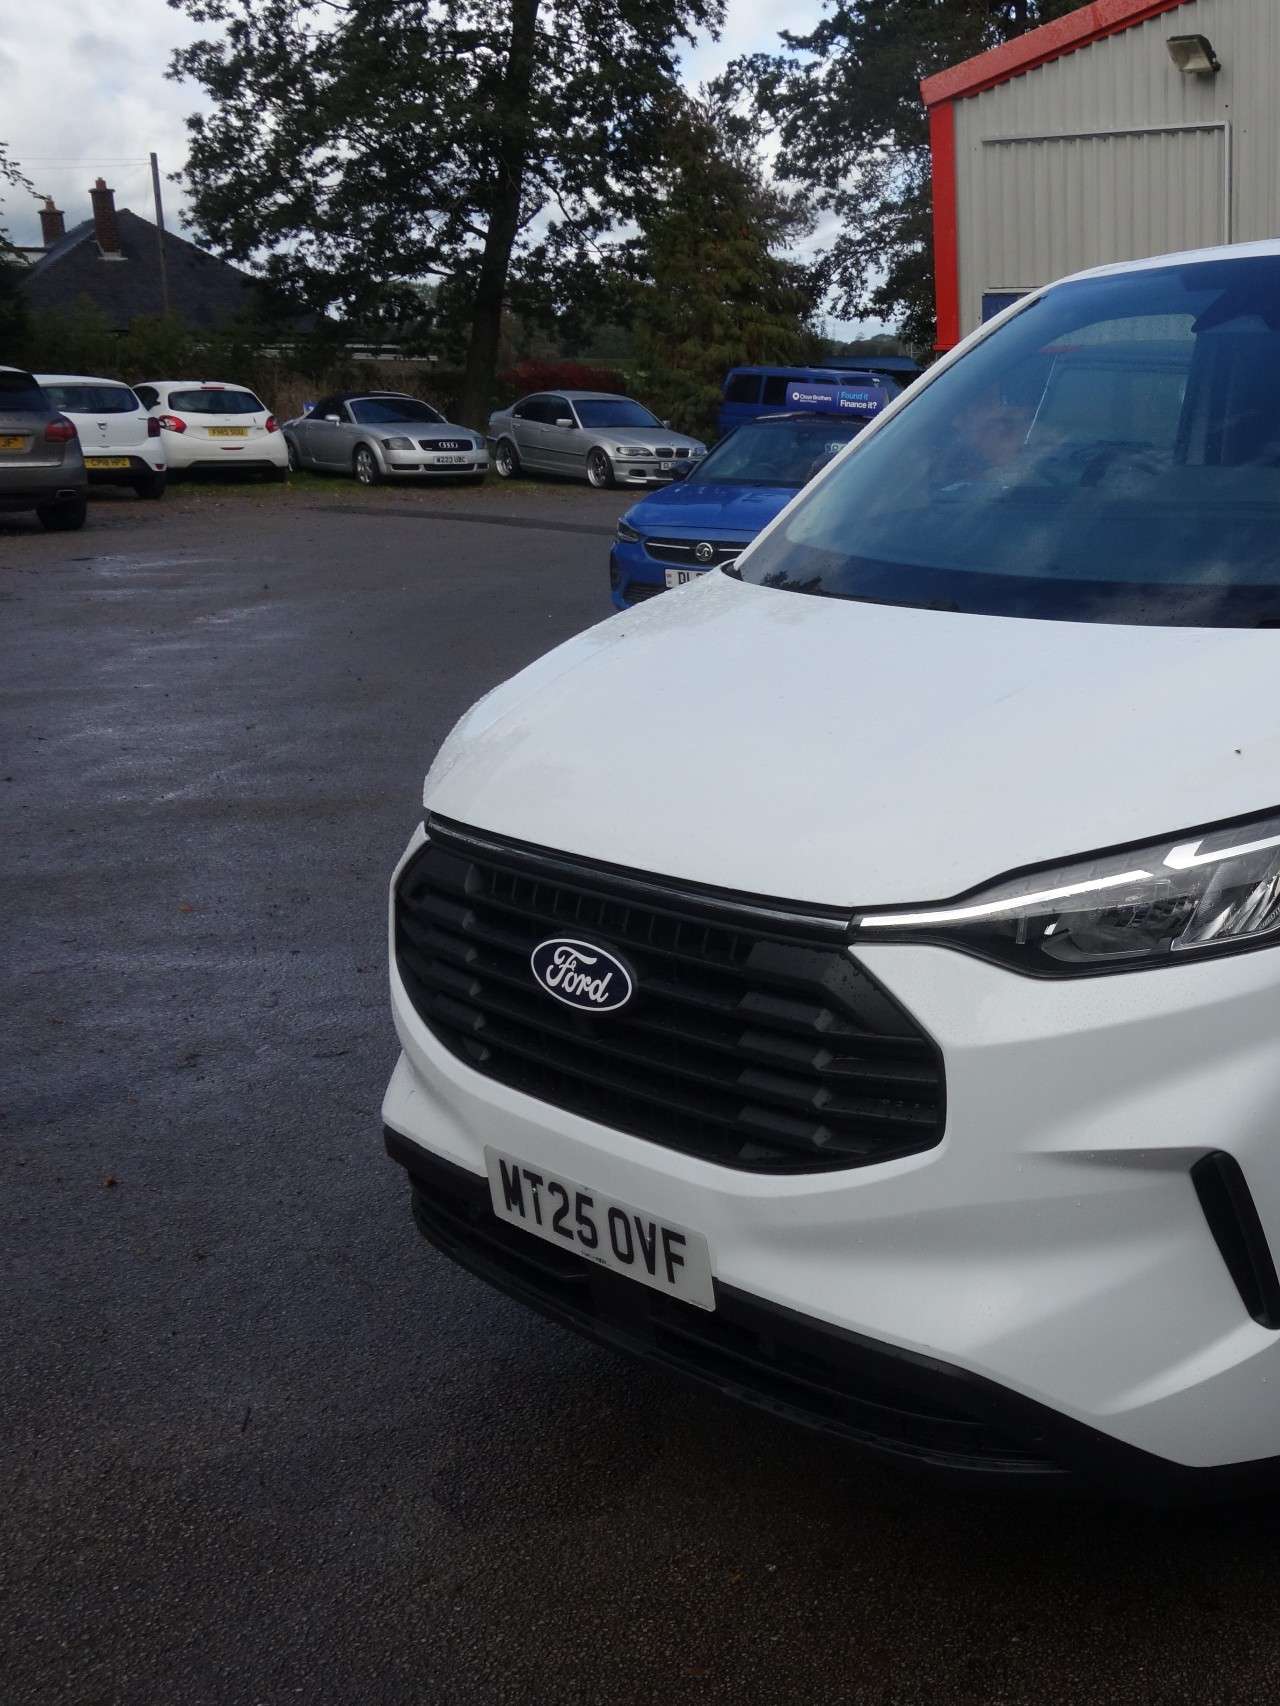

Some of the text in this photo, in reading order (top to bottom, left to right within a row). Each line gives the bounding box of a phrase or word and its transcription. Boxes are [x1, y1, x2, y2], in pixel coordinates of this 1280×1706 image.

[840, 400, 877, 409] Finance it?
[841, 391, 863, 399] Found
[546, 946, 613, 1003] Ford
[499, 1159, 686, 1284] MT25 OVF
